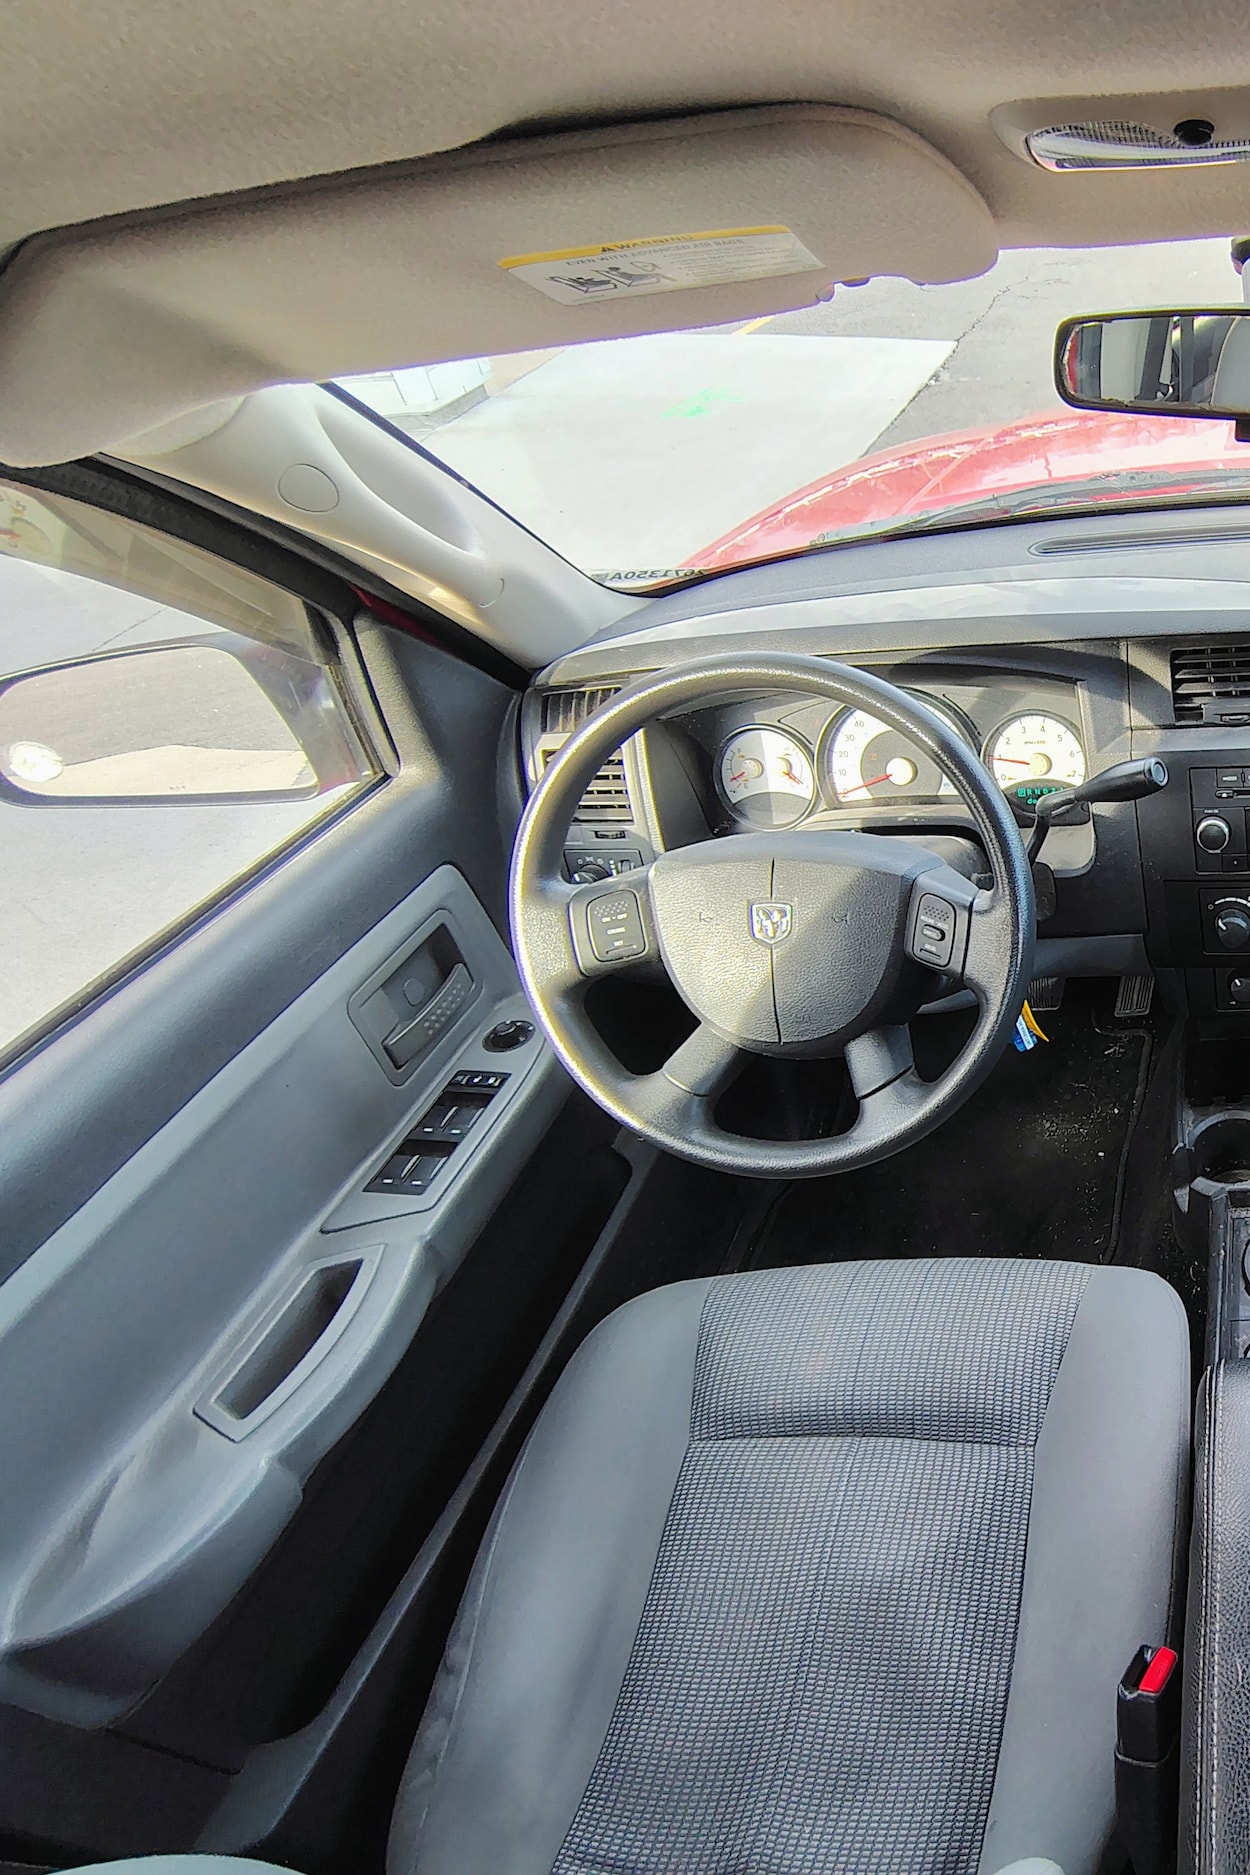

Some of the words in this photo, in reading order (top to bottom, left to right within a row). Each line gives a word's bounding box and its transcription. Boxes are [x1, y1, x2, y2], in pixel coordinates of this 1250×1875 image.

[614, 235, 693, 249] WARNING
[600, 253, 627, 263] WITH
[693, 241, 713, 249] AIR
[854, 720, 865, 728] 40
[838, 750, 849, 758] 20
